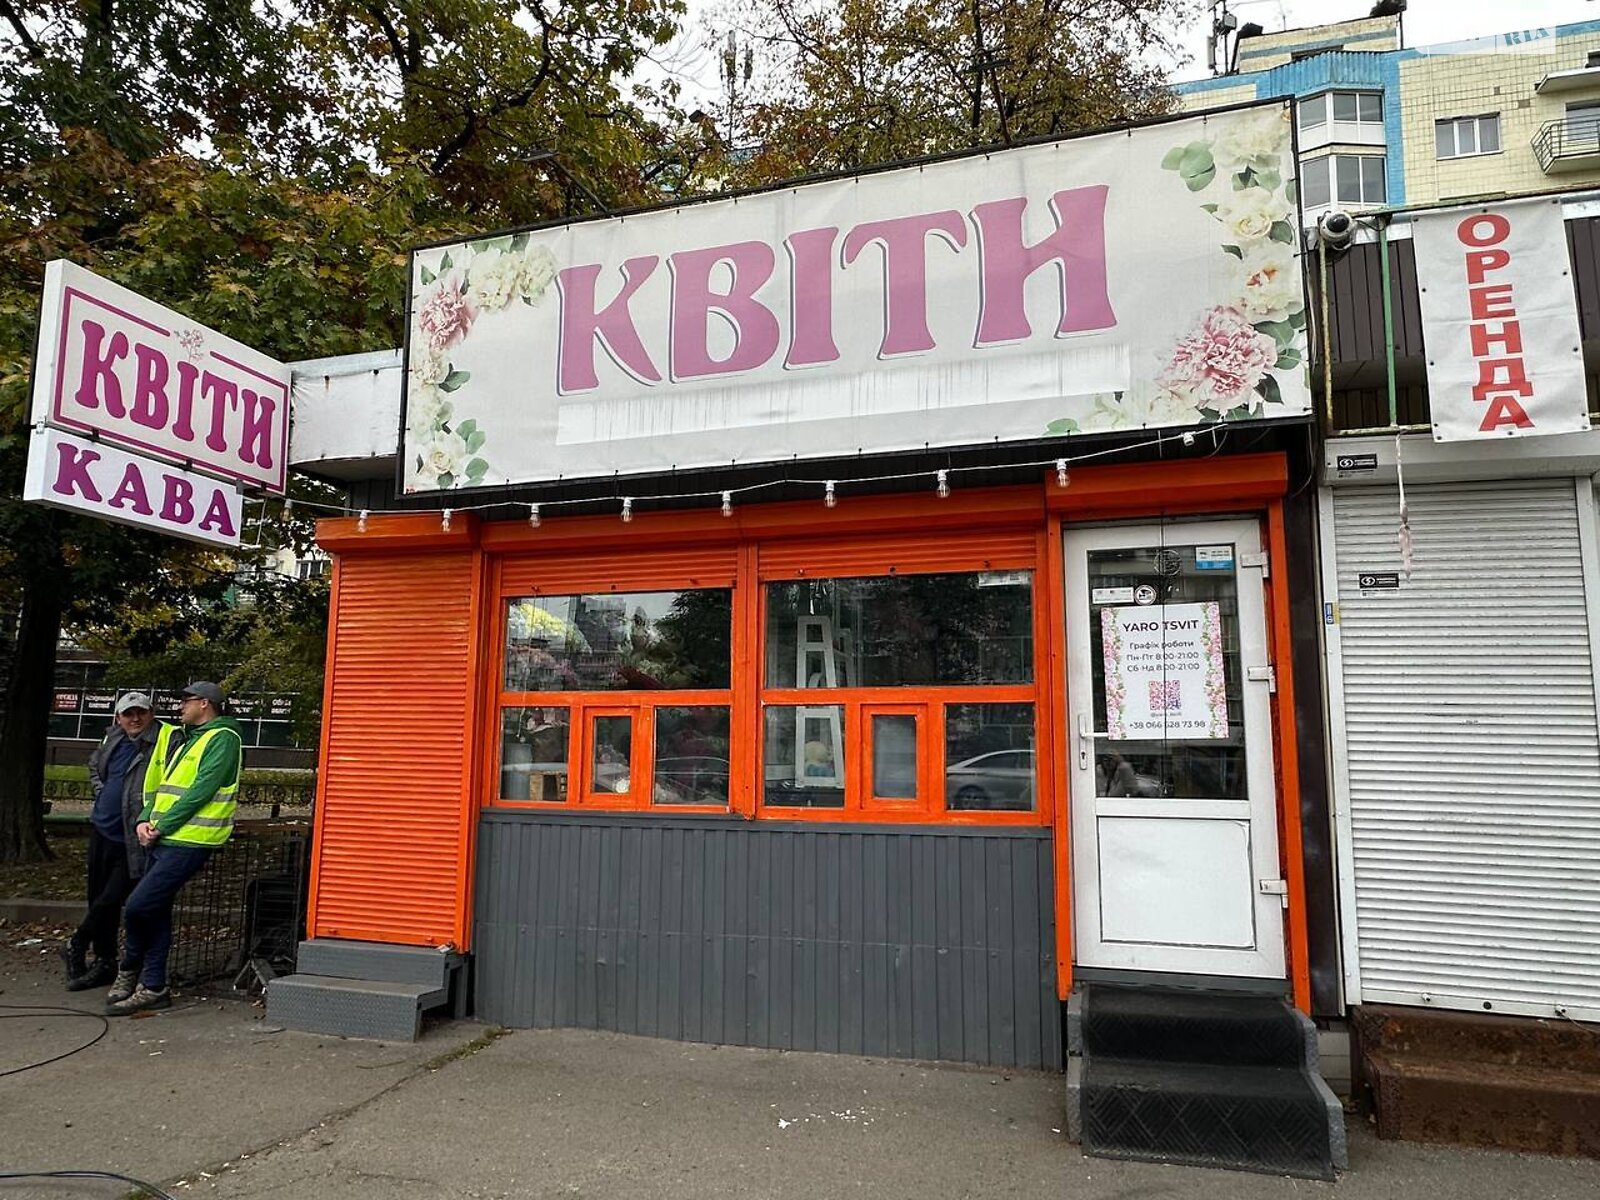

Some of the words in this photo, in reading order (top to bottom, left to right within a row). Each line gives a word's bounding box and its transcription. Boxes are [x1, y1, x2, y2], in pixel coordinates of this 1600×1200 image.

[556, 184, 1119, 395] КВІТИ
[1457, 213, 1536, 432] ОРЕНДА
[75, 319, 276, 470] КВІТИ
[52, 442, 237, 537] КАВА
[1122, 621, 1159, 632] YARO
[1162, 619, 1199, 631] TSVIT
[1129, 640, 1160, 651] Графік
[1161, 639, 1194, 650] роботи
